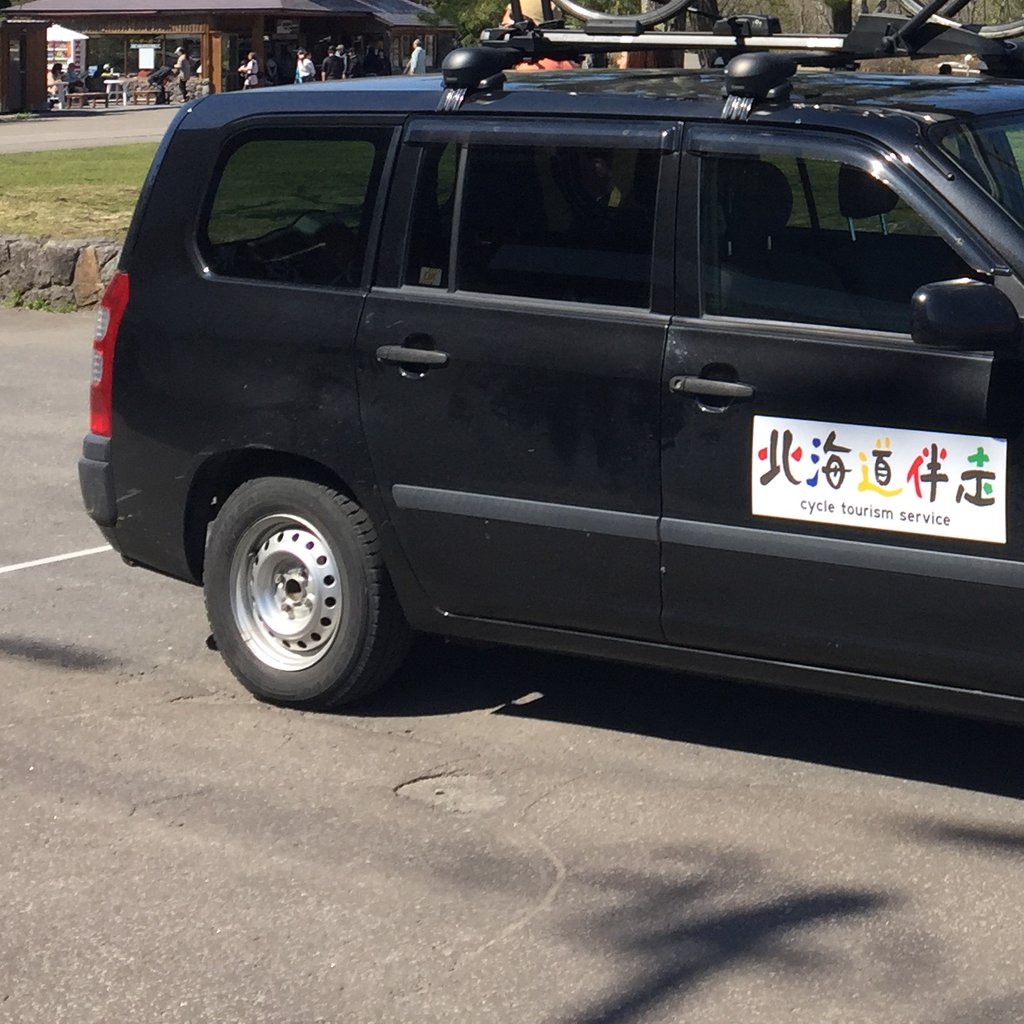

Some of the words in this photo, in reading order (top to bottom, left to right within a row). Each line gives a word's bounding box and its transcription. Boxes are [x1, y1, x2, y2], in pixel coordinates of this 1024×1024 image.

[757, 429, 997, 507] 北海道伴走
[800, 499, 835, 515] cycle
[841, 501, 894, 520] tourism
[899, 511, 951, 526] service
